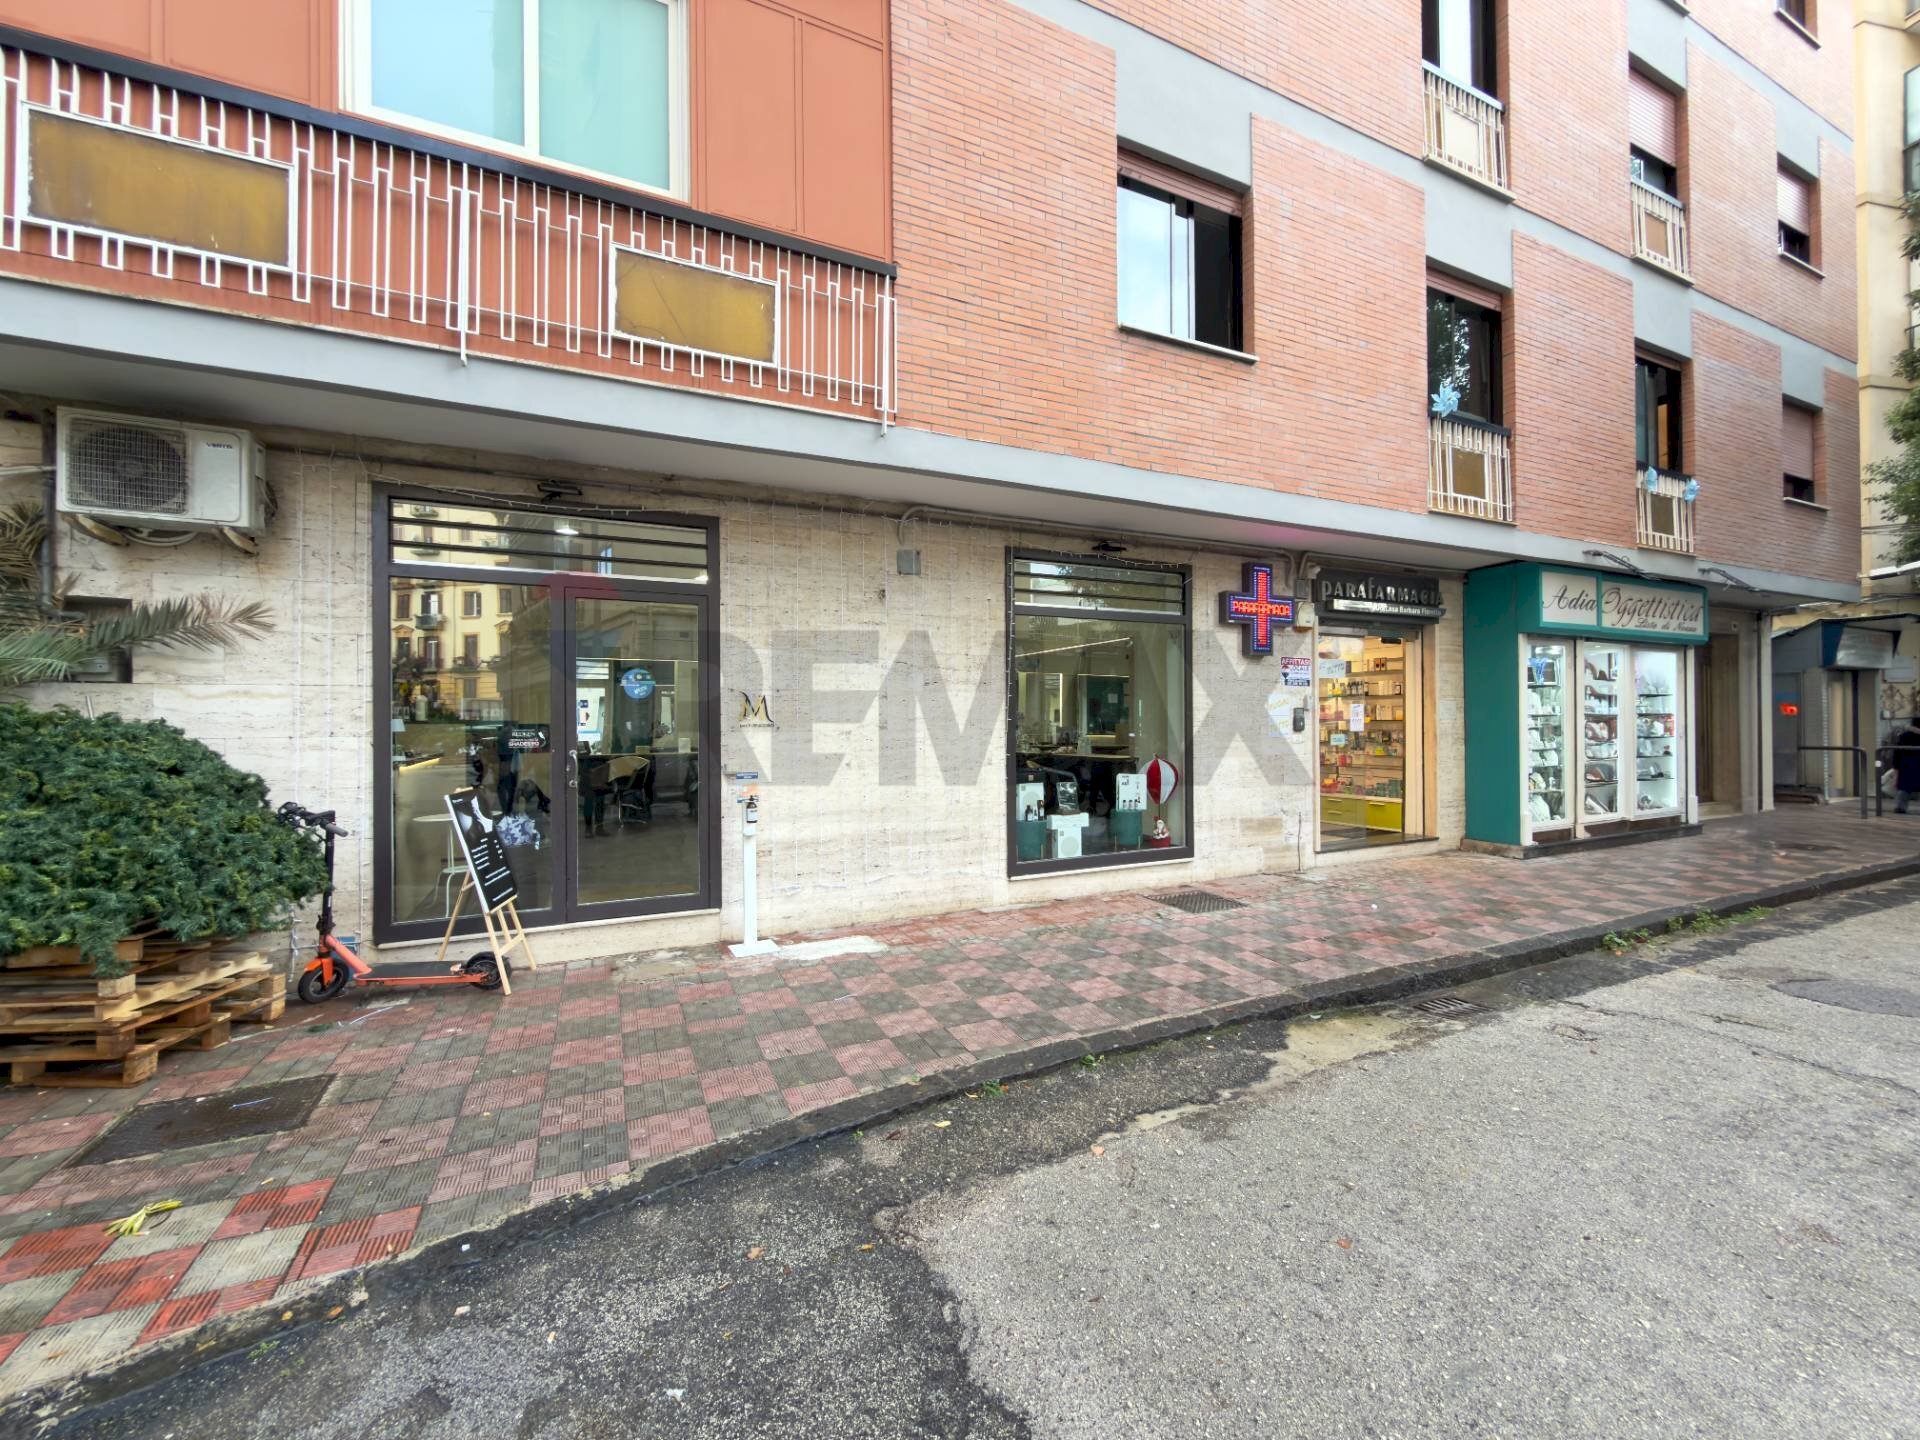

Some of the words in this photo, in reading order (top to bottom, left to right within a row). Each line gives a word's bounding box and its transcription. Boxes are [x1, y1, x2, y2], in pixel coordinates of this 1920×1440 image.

[1231, 601, 1290, 616] PARAFARMACIA
[1542, 584, 1597, 612] Adia
[1600, 586, 1701, 627] Oggettistica
